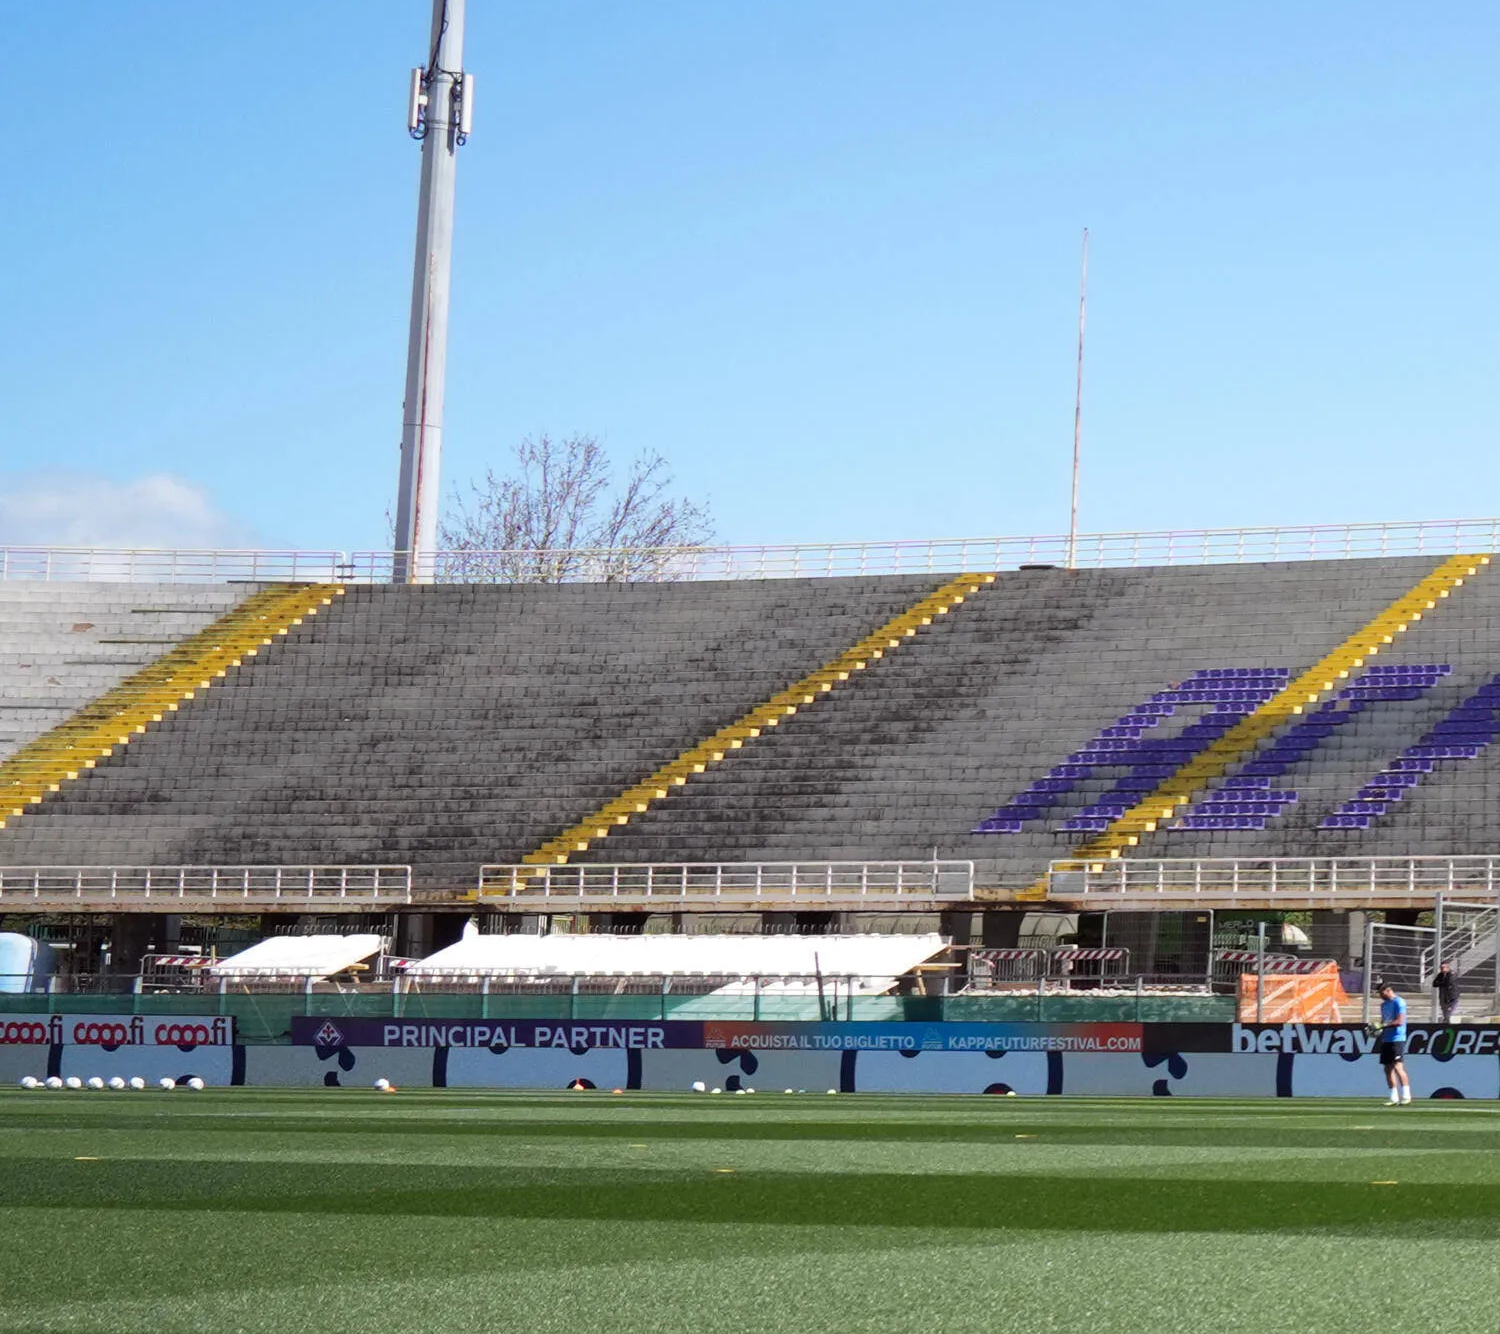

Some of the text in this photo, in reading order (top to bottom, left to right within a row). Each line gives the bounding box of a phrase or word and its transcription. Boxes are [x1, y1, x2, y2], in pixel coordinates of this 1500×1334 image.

[383, 1026, 665, 1049] PRINCIPAL PARTNER
[731, 1035, 798, 1048] ACQUISTA
[800, 1035, 811, 1048] IL
[814, 1035, 842, 1048] TUO
[844, 1035, 915, 1048] BIGLIETTO
[949, 1037, 1141, 1050] KAPPAFUTURFESTIVAL.COM
